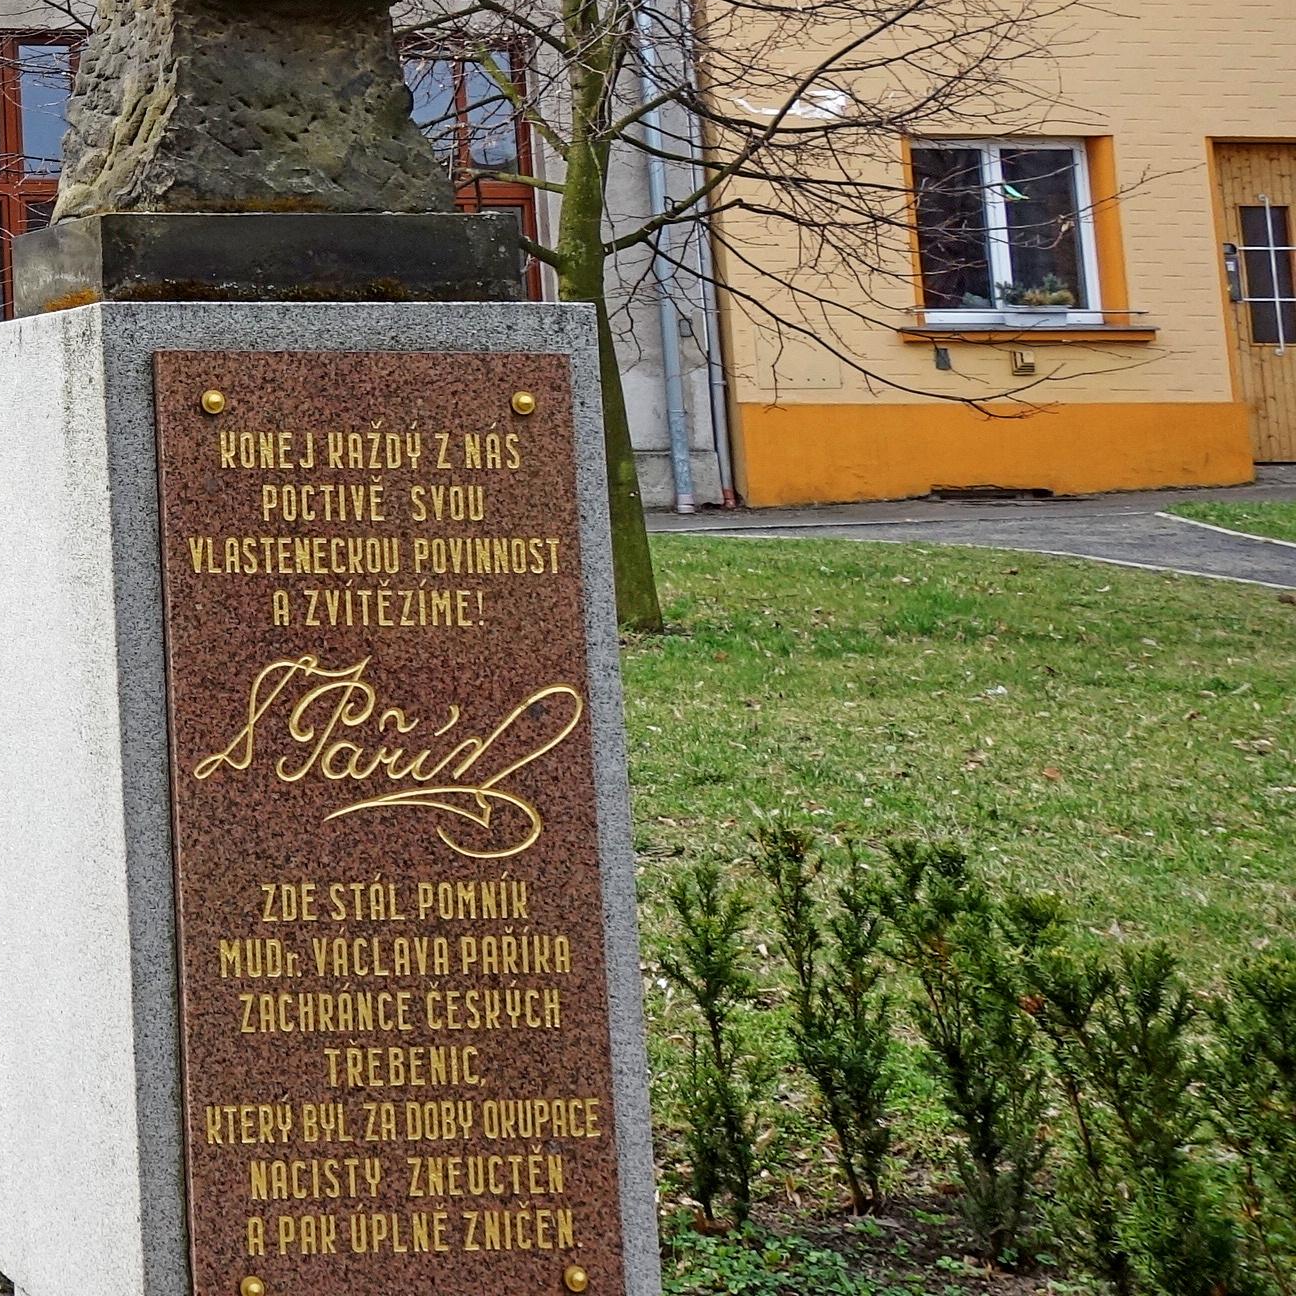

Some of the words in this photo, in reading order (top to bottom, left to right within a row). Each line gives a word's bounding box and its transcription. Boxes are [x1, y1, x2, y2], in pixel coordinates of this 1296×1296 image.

[220, 431, 314, 469] KONEJ
[328, 420, 420, 469] KAŽDÝ
[435, 432, 452, 469] Z
[464, 422, 521, 469] NÁS
[262, 475, 385, 521] POCTIVĚ
[410, 485, 484, 521] SVOU
[188, 537, 400, 574] VLASTENECKOU
[414, 537, 560, 574] POVINNOST
[272, 589, 290, 626] A
[304, 578, 485, 626] ZVÍTĚZÍME!
[261, 883, 317, 922] ZDE
[329, 872, 406, 921] STÁL
[418, 871, 529, 920] POMNÍK
[219, 939, 303, 978] MUDr.
[312, 927, 450, 977] VÁCLAVA
[461, 925, 571, 974] PAŘÍKA
[239, 982, 413, 1032] ZACHRÁNCE
[426, 980, 561, 1030] ČESKÝCH
[324, 1039, 486, 1087] TŘEBENIC,
[206, 1093, 292, 1144] KTERÝ
[303, 1103, 354, 1142] BYL
[362, 1103, 396, 1141] ZA
[406, 1100, 474, 1140] DOBY
[483, 1098, 602, 1139] OKUPACE
[250, 1158, 382, 1200] NACISTY
[407, 1144, 564, 1197] ZNEUCTĚN
[247, 1216, 266, 1255] A
[278, 1214, 337, 1255] PAK
[350, 1202, 449, 1252] ÚPLNĚ
[463, 1200, 584, 1250] ZNIČEN.
